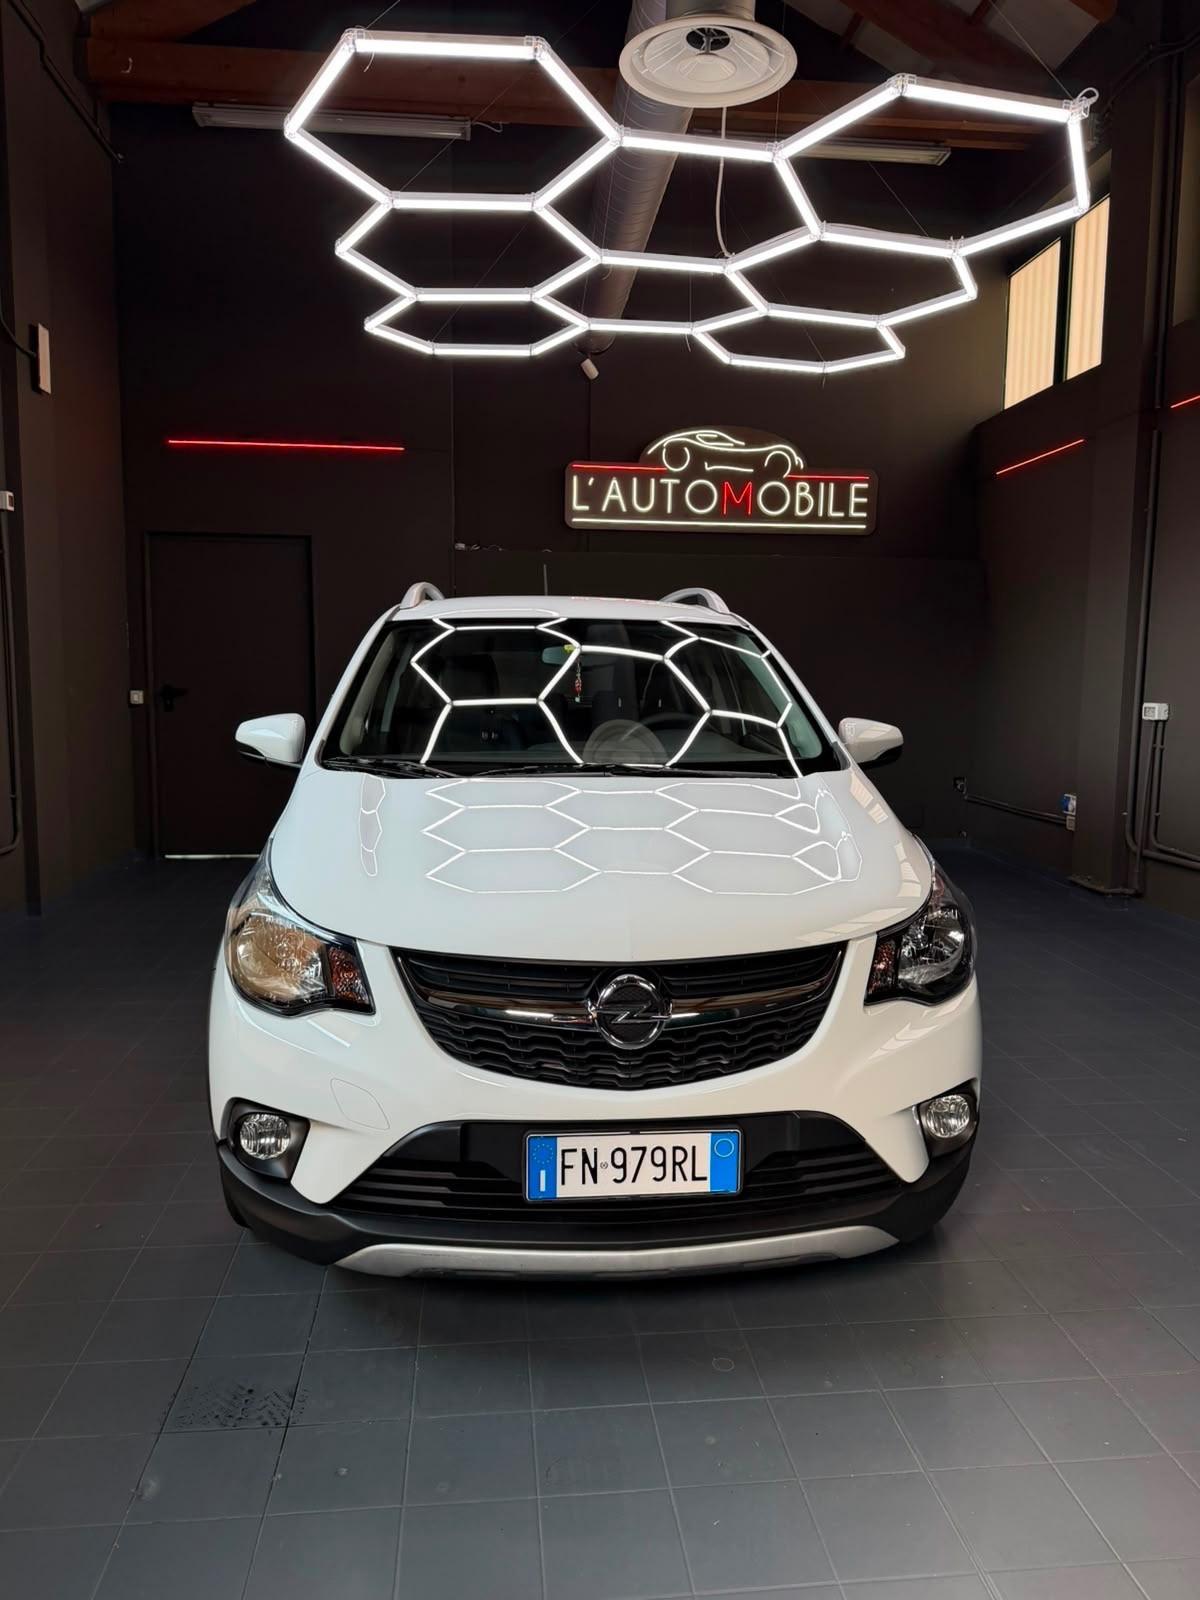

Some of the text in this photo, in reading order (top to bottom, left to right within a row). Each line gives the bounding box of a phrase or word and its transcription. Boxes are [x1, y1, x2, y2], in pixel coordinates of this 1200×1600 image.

[571, 475, 869, 517] L'AUTOMOBILE
[560, 1145, 708, 1185] FN 979RL
